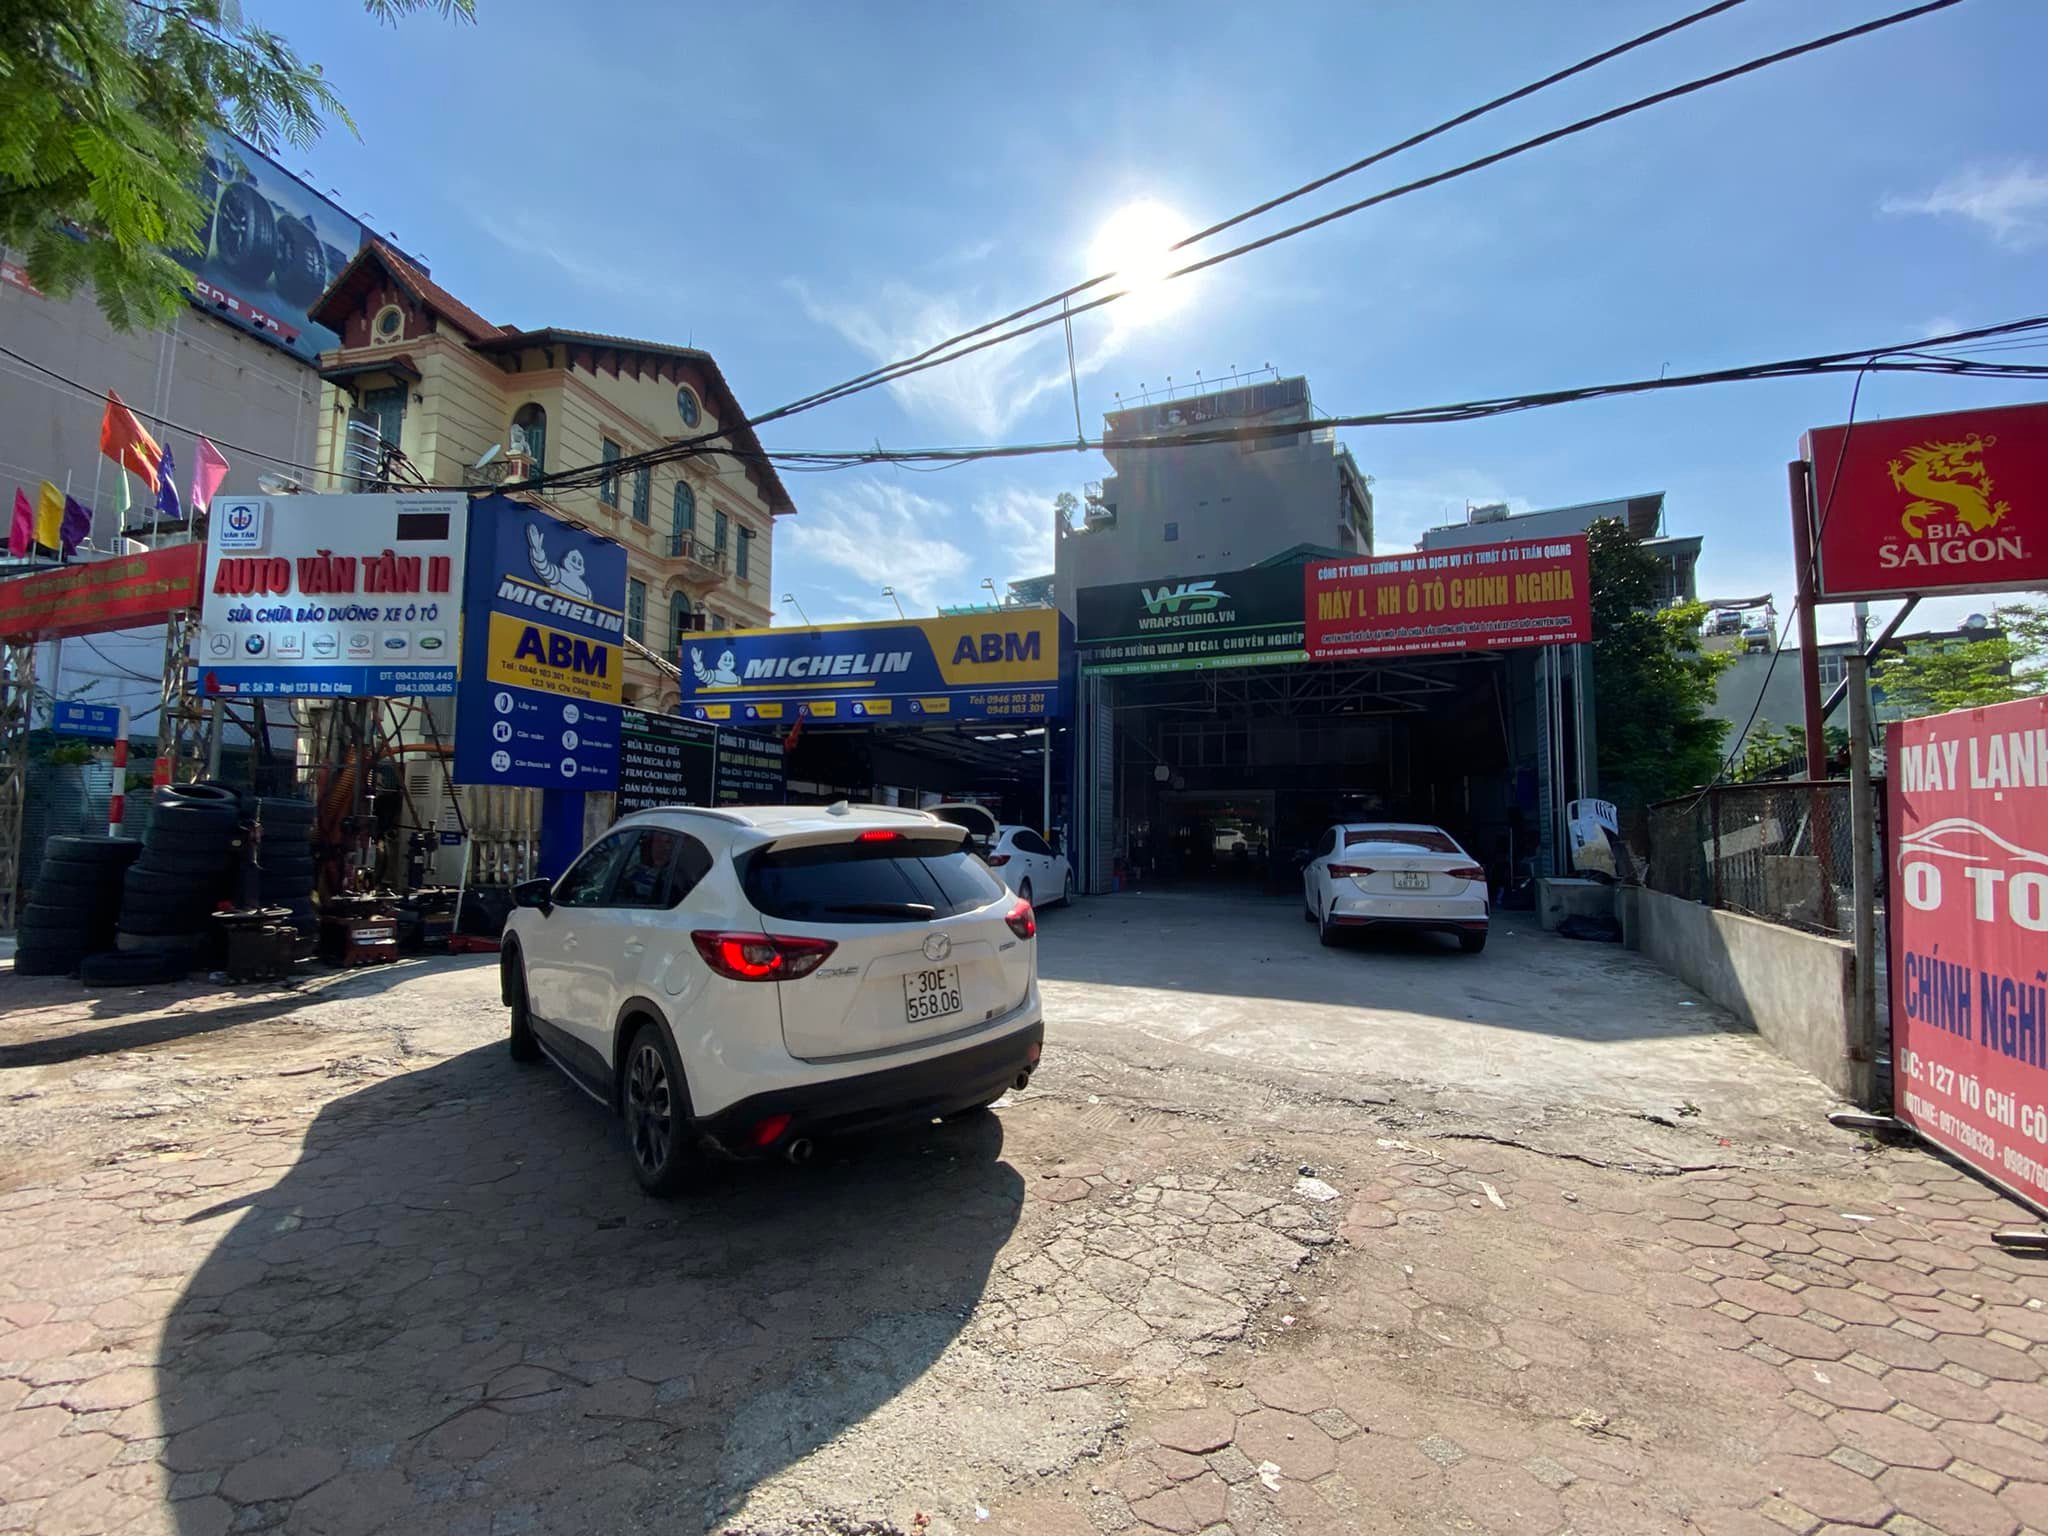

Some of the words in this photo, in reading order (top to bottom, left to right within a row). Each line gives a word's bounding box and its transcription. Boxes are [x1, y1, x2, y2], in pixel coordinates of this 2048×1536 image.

[1927, 523, 1971, 539] BIA
[1318, 566, 1338, 580] CÔNG
[1339, 567, 1348, 578] TY
[1350, 564, 1369, 577] TNHH
[1400, 559, 1415, 573] MẠI
[1416, 555, 1427, 570] VÀ
[1429, 555, 1448, 570] DỊCH
[1449, 554, 1460, 569] VỤ
[1501, 548, 1508, 562] Ô
[1509, 547, 1519, 561] TÔ
[1544, 543, 1572, 558] QUANG
[1879, 536, 2022, 568] SAIGON
[213, 557, 290, 594] AUTO
[296, 549, 356, 594] VĂN
[427, 556, 450, 593] II
[497, 581, 623, 632] MICHELIN
[1141, 580, 1228, 614] WS
[1318, 586, 1352, 620] MÁY
[1407, 578, 1419, 614] Ô
[1422, 575, 1446, 612] TÔ
[1450, 572, 1509, 609] CHÍNH
[1515, 565, 1575, 603] NGHĨA
[227, 603, 253, 622] SỬA
[256, 604, 293, 622] CHỮA
[296, 602, 324, 622] BẢO
[327, 604, 379, 622] DƯỠNG
[382, 607, 402, 621] XE
[404, 603, 416, 621] Ô
[420, 603, 438, 621] TÔ
[1139, 610, 1236, 630] WRAPSTUDIO.VN
[514, 626, 607, 678] ABM
[952, 631, 1040, 664] ABM
[1157, 643, 1185, 655] WRAP
[1187, 639, 1219, 652] DECAL
[1223, 634, 1264, 649] CHUYÊN
[1267, 631, 1305, 646] NGHIỆP
[743, 652, 913, 679] MICHELIN
[626, 768, 642, 777] FILM
[1901, 732, 1959, 793] MÁY
[918, 969, 947, 994] 30E
[909, 990, 960, 1019] 558.06
[1905, 944, 1971, 1040] CHÍNH
[1980, 970, 2048, 1070] NGHĨ
[1927, 1061, 1955, 1096] 127
[1959, 1073, 1980, 1110] VÕ
[1985, 1088, 2015, 1129] CHÍ
